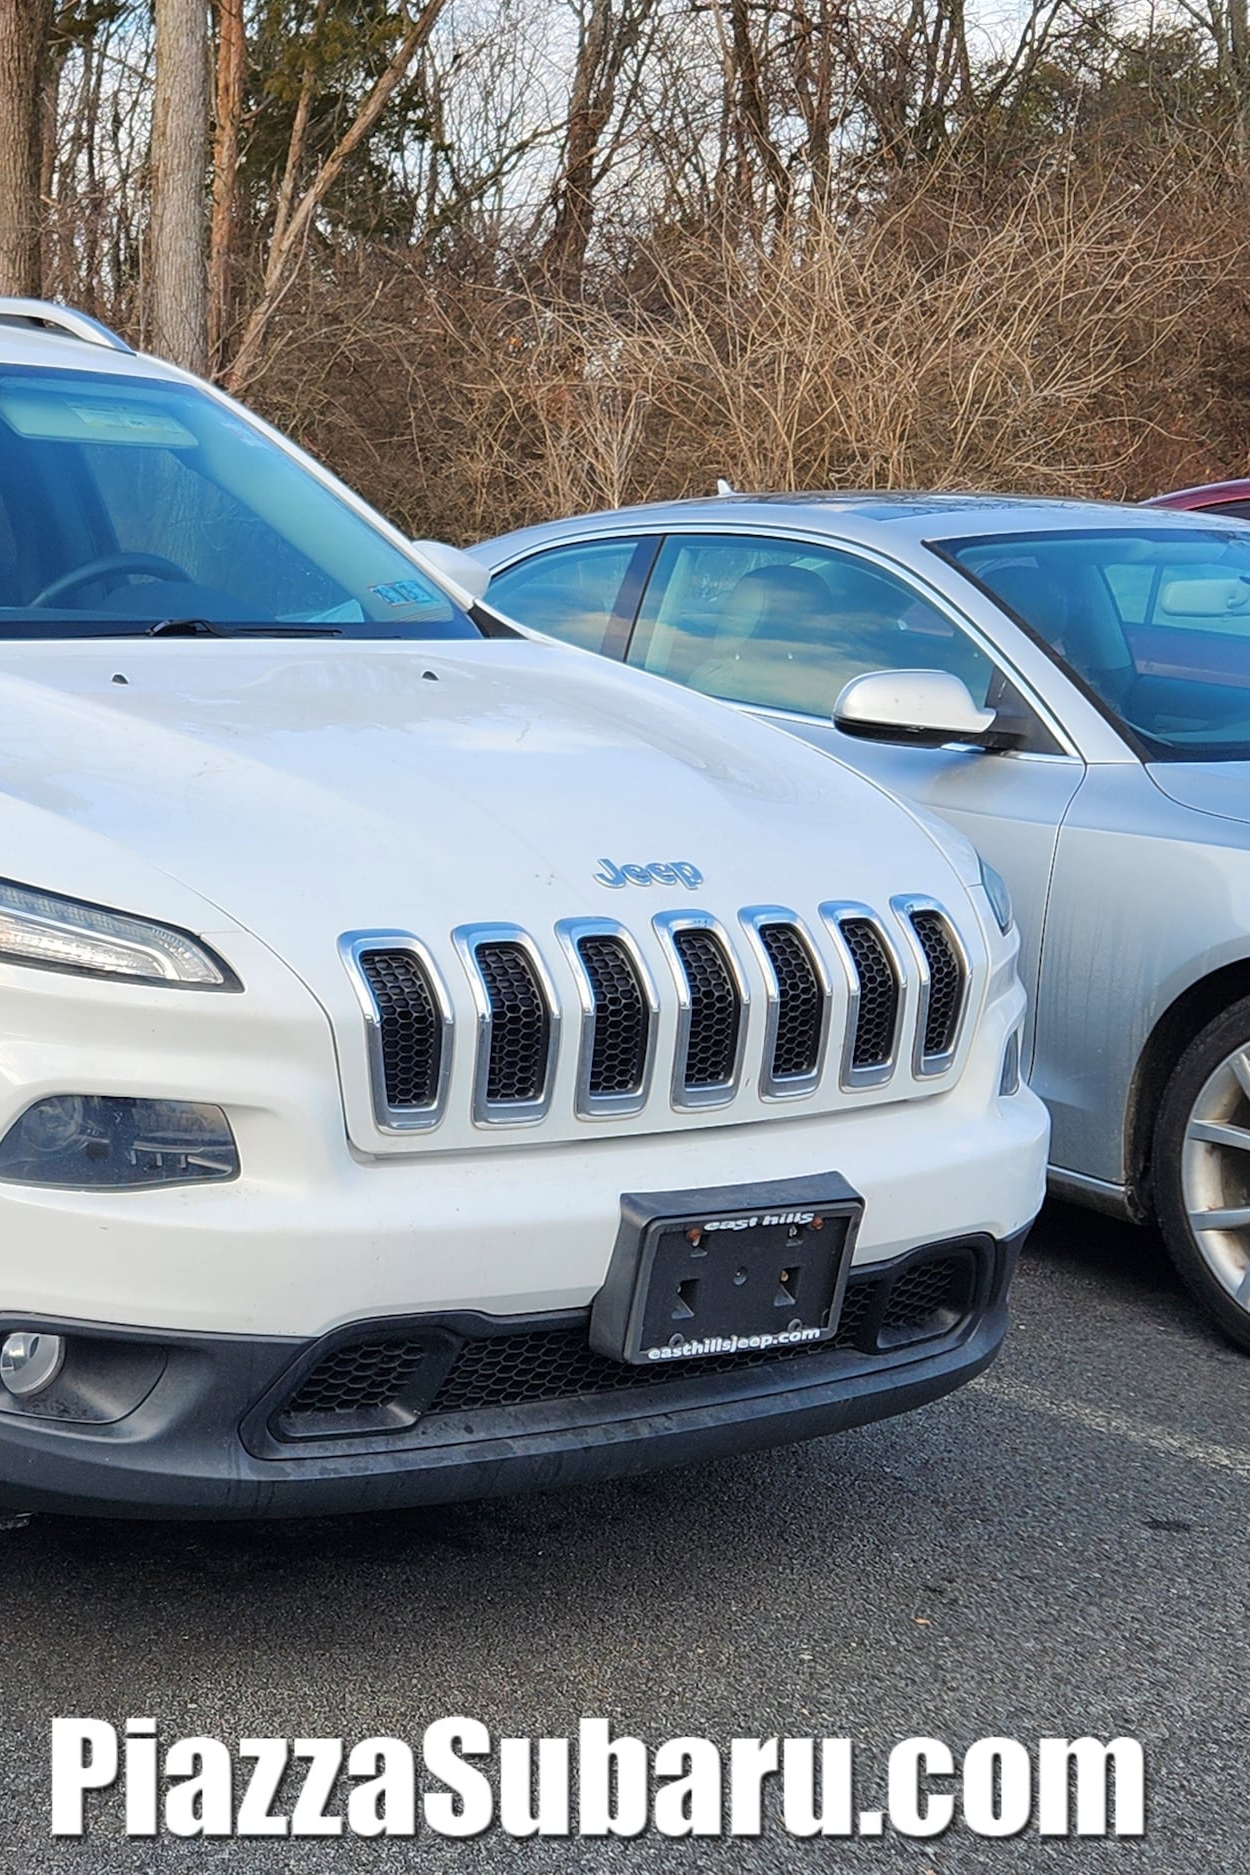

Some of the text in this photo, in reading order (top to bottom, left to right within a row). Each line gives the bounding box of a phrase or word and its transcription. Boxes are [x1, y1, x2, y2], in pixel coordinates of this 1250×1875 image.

[592, 858, 703, 890] Jeep
[703, 1212, 814, 1231] east hills
[648, 1328, 821, 1360] easthillsjeep.com
